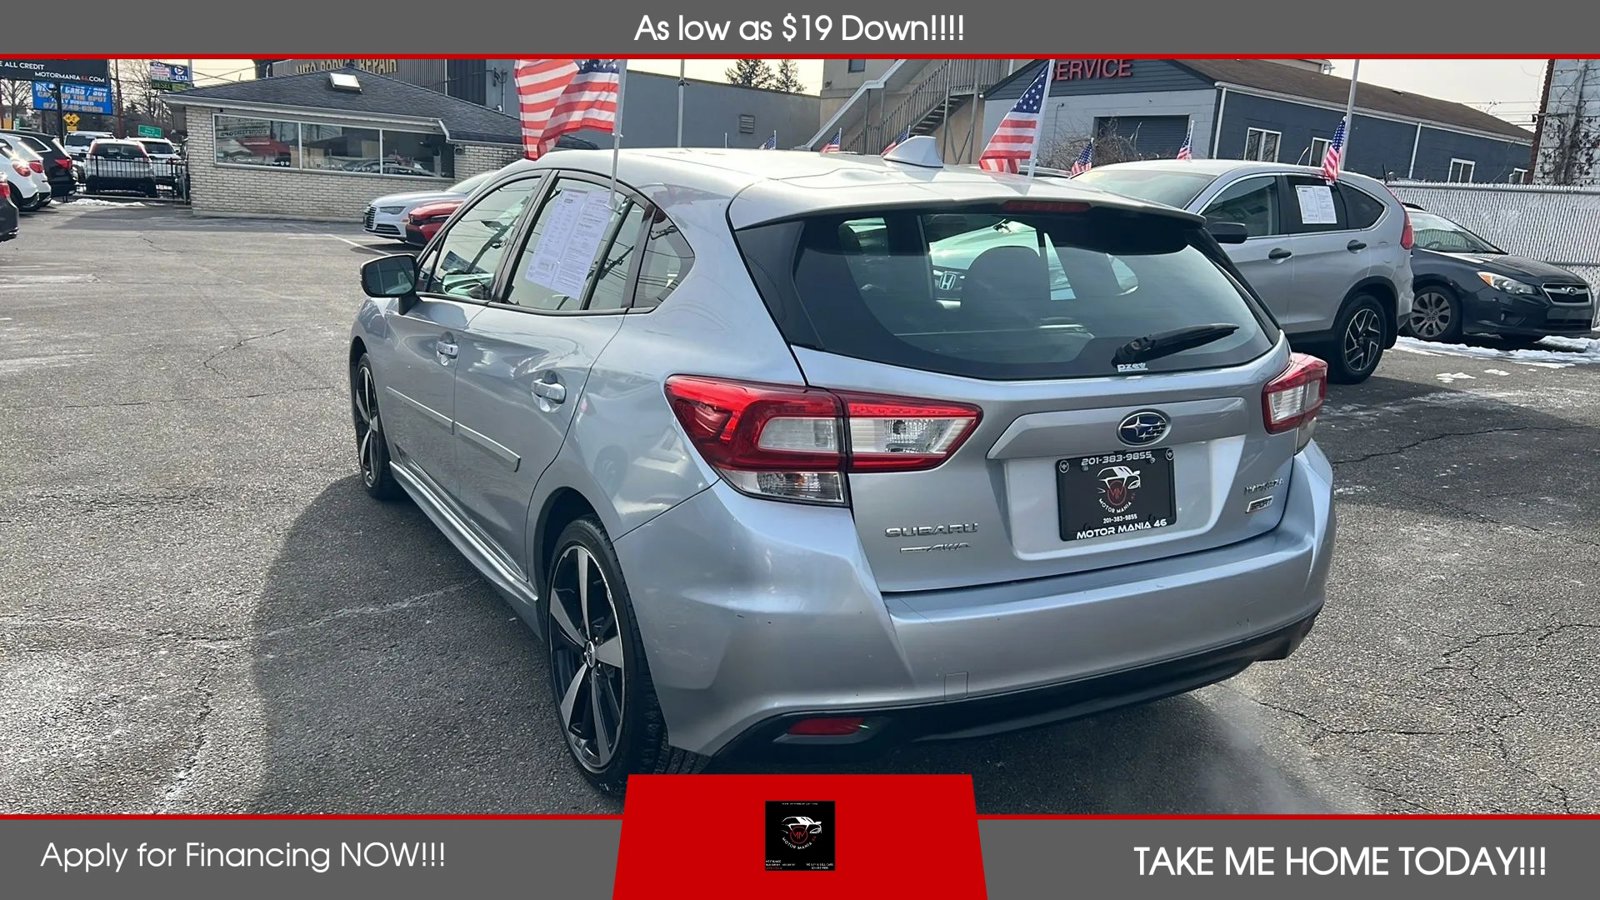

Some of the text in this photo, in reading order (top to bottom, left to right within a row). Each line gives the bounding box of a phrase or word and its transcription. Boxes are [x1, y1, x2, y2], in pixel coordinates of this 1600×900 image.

[4, 61, 18, 69] ALL
[19, 62, 45, 70] CREDIT
[1054, 59, 1132, 81] ERVICE
[1081, 451, 1152, 467] 201-383-9855
[1098, 498, 1132, 514] MOTOR MANIA
[884, 522, 979, 538] SUBARU
[1076, 518, 1168, 540] MOTOR MANIA 46
